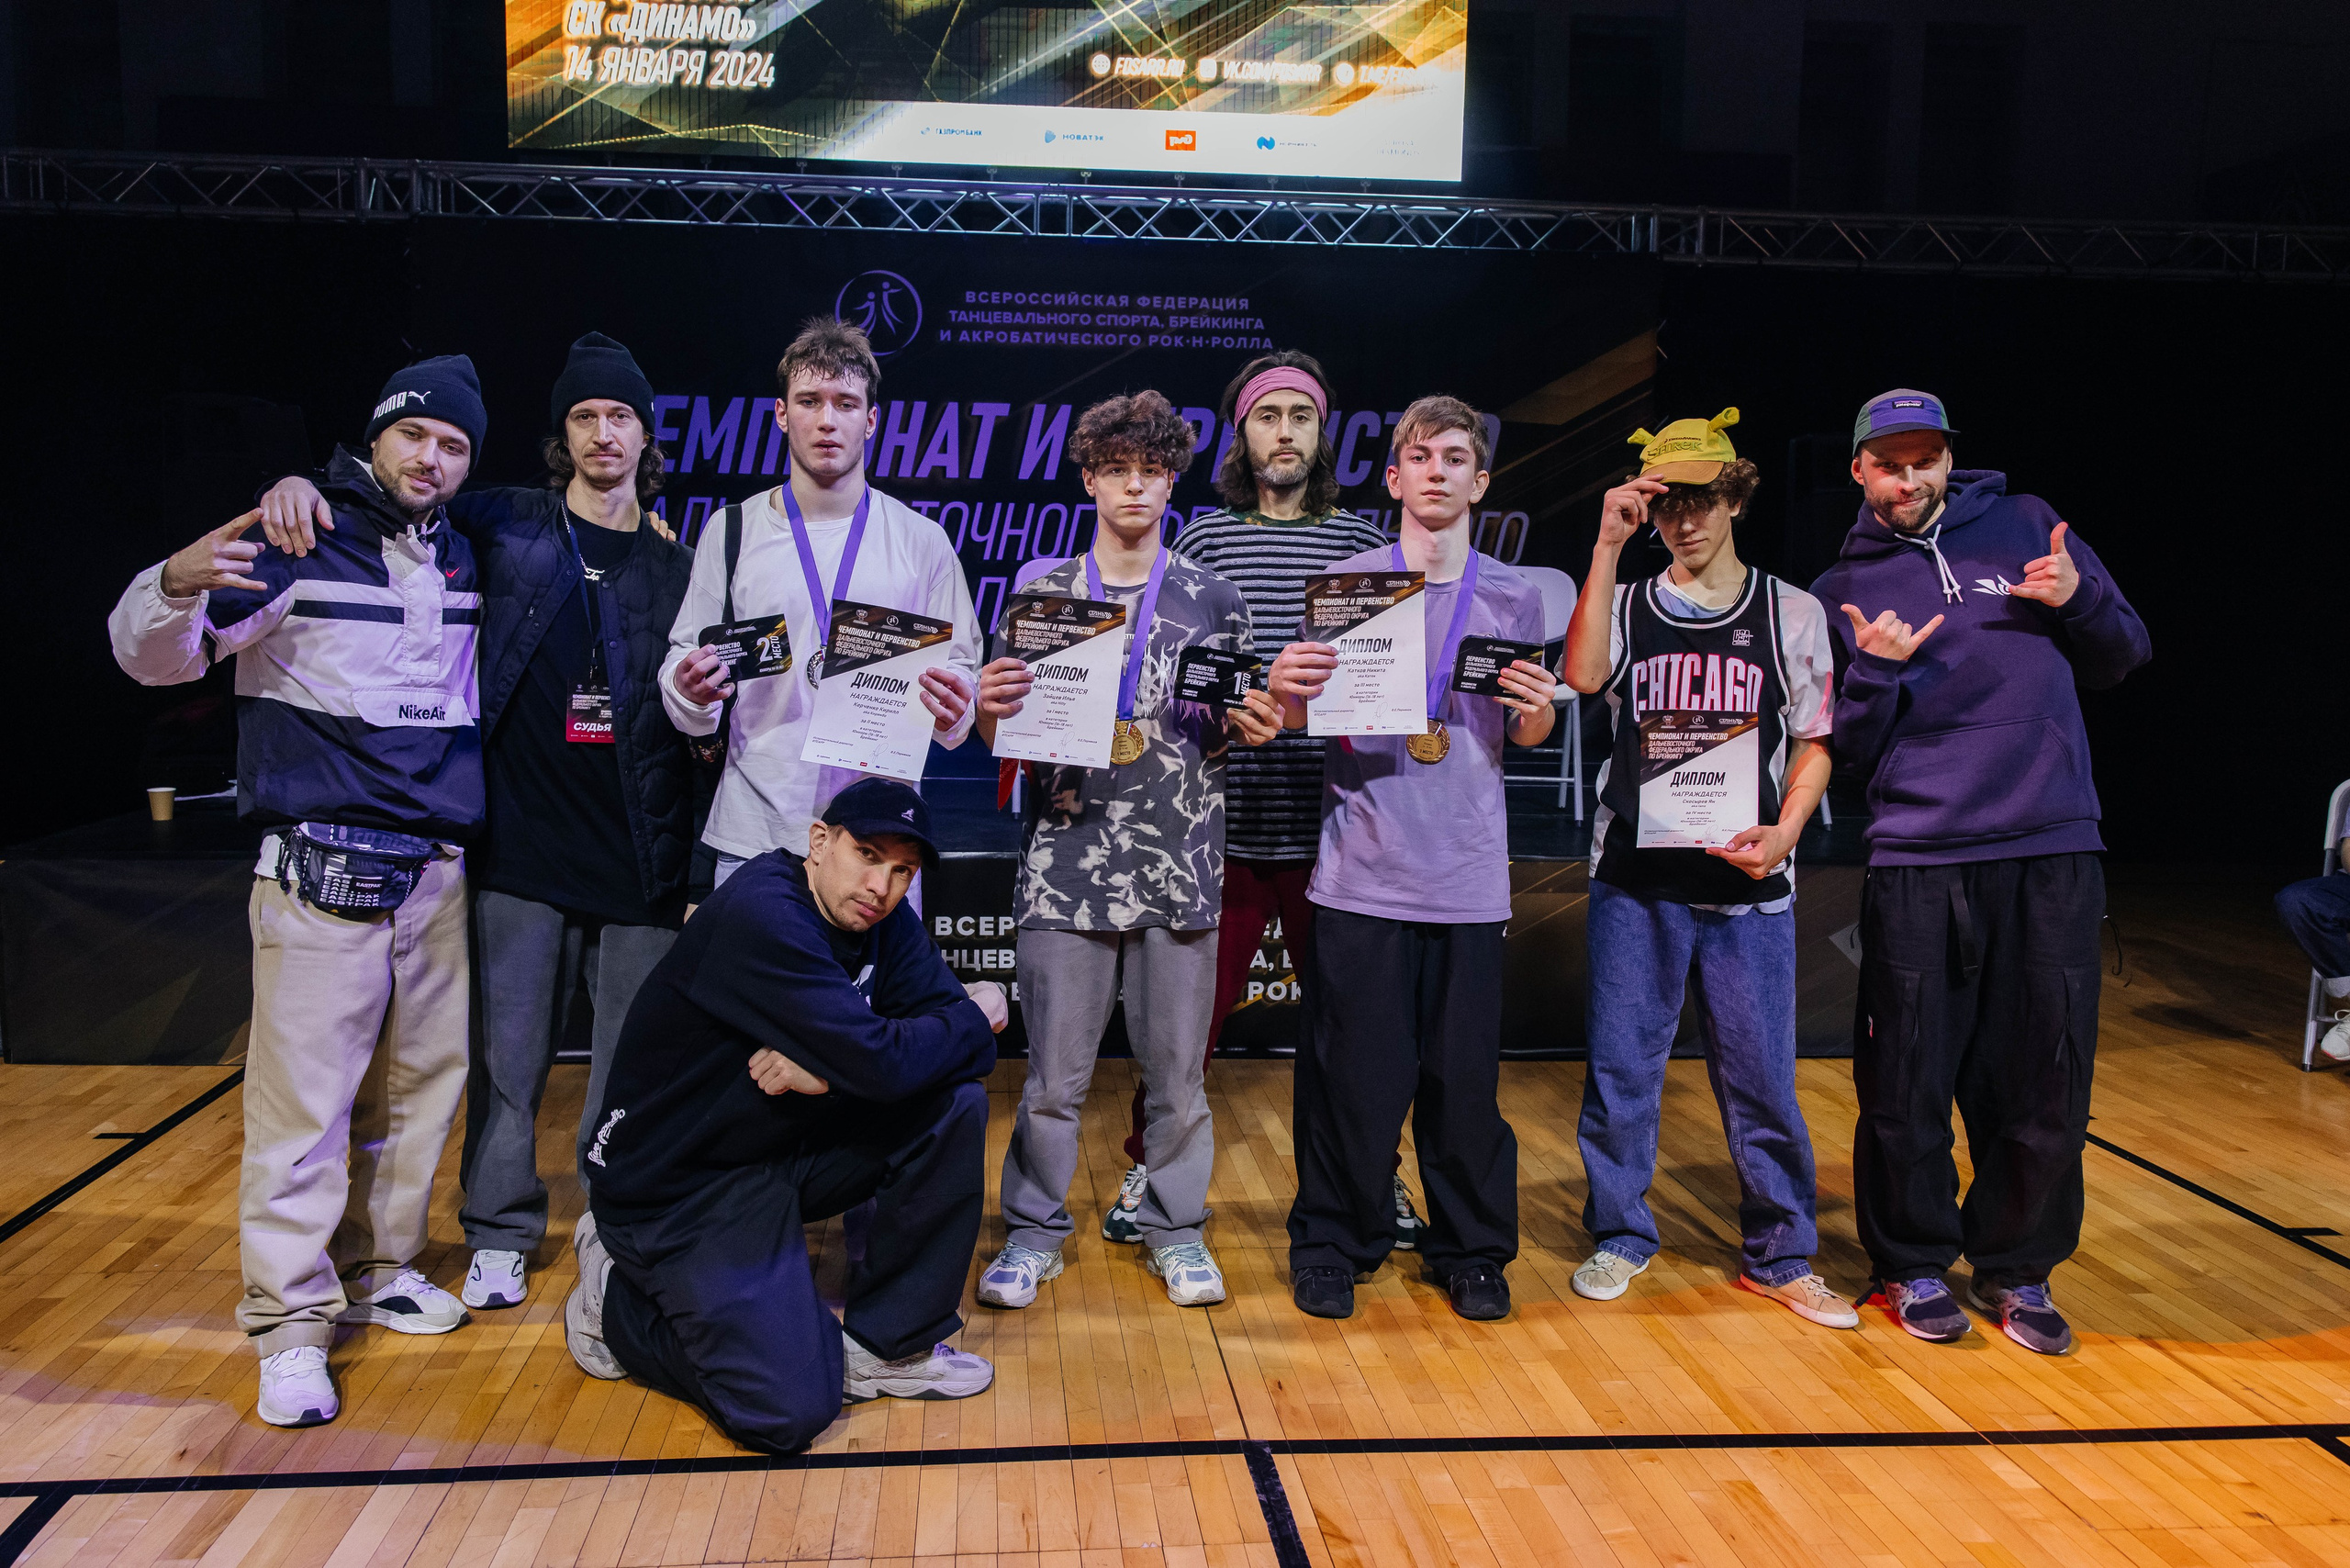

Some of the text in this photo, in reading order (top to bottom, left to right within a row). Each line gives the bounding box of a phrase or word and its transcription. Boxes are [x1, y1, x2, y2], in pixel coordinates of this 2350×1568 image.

[568, 1, 757, 43] СК «ДИНАМО»
[567, 46, 775, 87] 14 ЯНВАРЯ 2024
[966, 291, 1249, 311] ВСЕРОССИЙСКАЯ ФЕДЕРАЦИЯ
[948, 310, 1265, 330] ТАНЦЕВАЛЬНОГО СПОРТА, БРЕЙКИНГА
[940, 330, 951, 342] И
[958, 330, 1141, 346] АКРОБАТИЧЕСКОГО
[373, 391, 407, 421] PUMA
[1018, 404, 1072, 480] И
[1314, 598, 1348, 606] ЧЕМПИОНАТ
[1356, 597, 1395, 605] ПЕРВЕНСТВО
[838, 625, 874, 639] ЧЕМПИОНАТ
[881, 633, 921, 648] ПЕРВЕНСТВО
[1016, 620, 1051, 631] ЧЕМПИОНАТ
[1058, 624, 1096, 635] ПЕРВЕНСТВО
[716, 642, 741, 651] РВЕНСТВО
[756, 637, 773, 662] 2
[770, 635, 783, 659] МЕСТО
[1338, 638, 1393, 655] ДИПЛОМ
[1187, 663, 1216, 673] ПЕРВЕНСТВО
[1465, 655, 1495, 665] ПЕРВЕНСТВО
[1035, 664, 1089, 683] ДИПЛОМ
[1184, 678, 1208, 687] БРЕЙКИНГ
[1462, 670, 1487, 679] БРЕЙКИНГ
[850, 672, 910, 696] ДИПЛОМ
[1033, 684, 1089, 695] НАГРАЖДАЕТСЯ
[1234, 671, 1242, 695] 1
[1240, 673, 1251, 696] МЕСТО
[1632, 653, 1764, 722] CHICAGO
[850, 692, 908, 708] НАГРАЖДАЕТСЯ
[573, 722, 612, 733] СУДЬЯ
[1689, 733, 1729, 741] ПЕРВЕНСТВО
[1670, 771, 1726, 788] ДИПЛОМ
